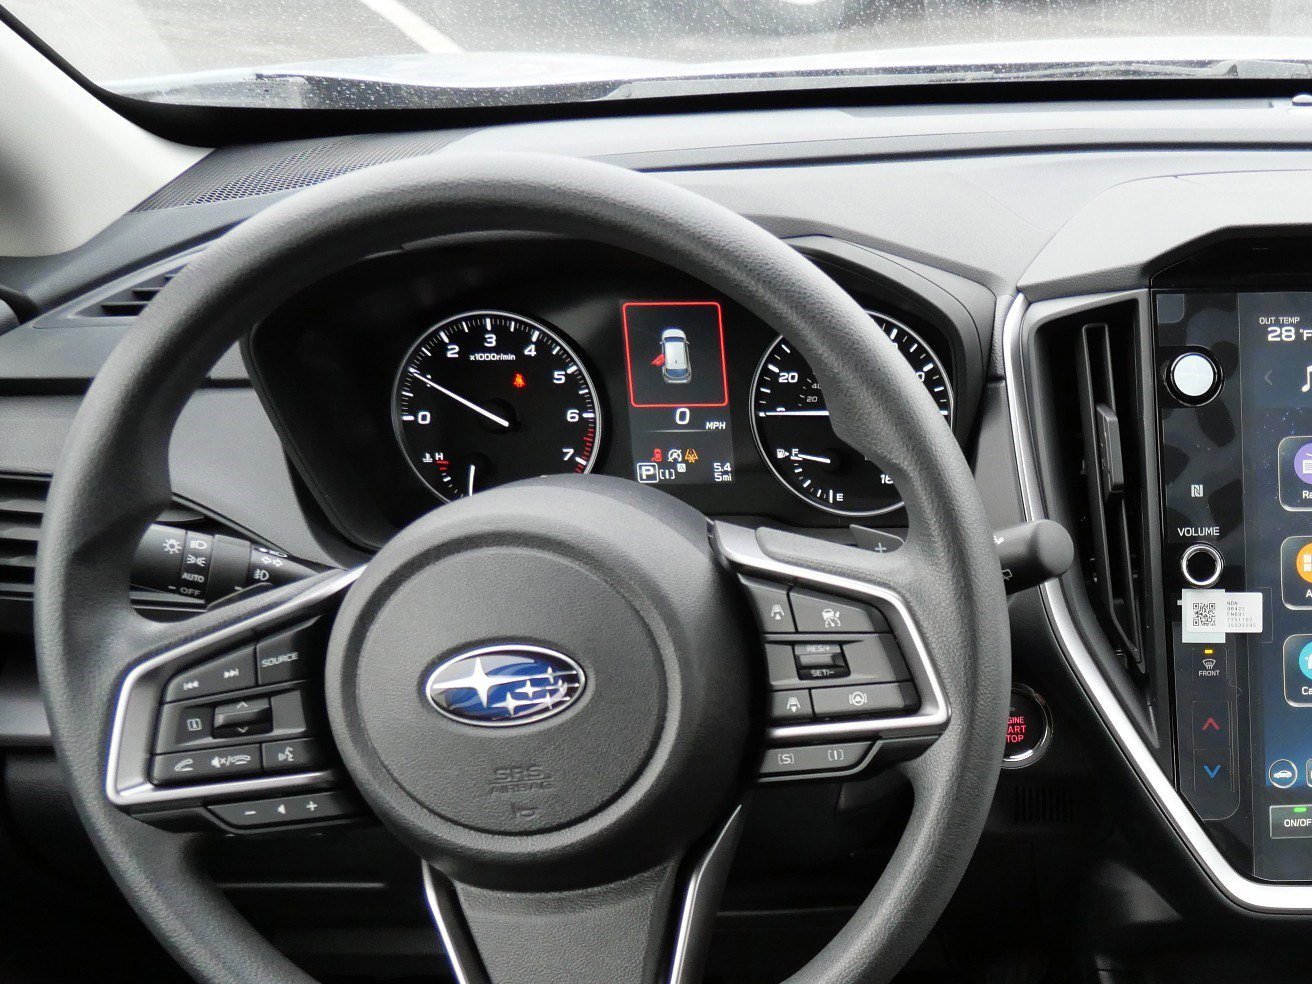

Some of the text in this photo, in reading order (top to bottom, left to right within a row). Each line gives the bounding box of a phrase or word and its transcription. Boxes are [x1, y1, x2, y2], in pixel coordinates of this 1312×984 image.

[1259, 316, 1300, 325] OUT TEMP
[1267, 326, 1296, 341] 28
[484, 334, 496, 347] 3
[447, 346, 459, 358] 2
[524, 345, 536, 357] 4
[469, 353, 516, 361] x1000r/min
[553, 371, 565, 384] 5
[778, 372, 799, 383] 20
[417, 411, 431, 425] 0
[566, 410, 579, 422] 6
[676, 408, 690, 425] 0
[706, 421, 726, 430] MPH
[562, 448, 574, 461] 7
[641, 466, 654, 479] P
[713, 463, 731, 472] 5.4
[714, 473, 732, 481] 5mi
[836, 493, 843, 501] E
[1177, 527, 1220, 537] VOLUME
[182, 572, 205, 583] AUTO
[180, 587, 201, 597] OFF
[261, 652, 299, 668] SOURCE
[1007, 725, 1026, 733] ART
[1005, 734, 1024, 743] TOP
